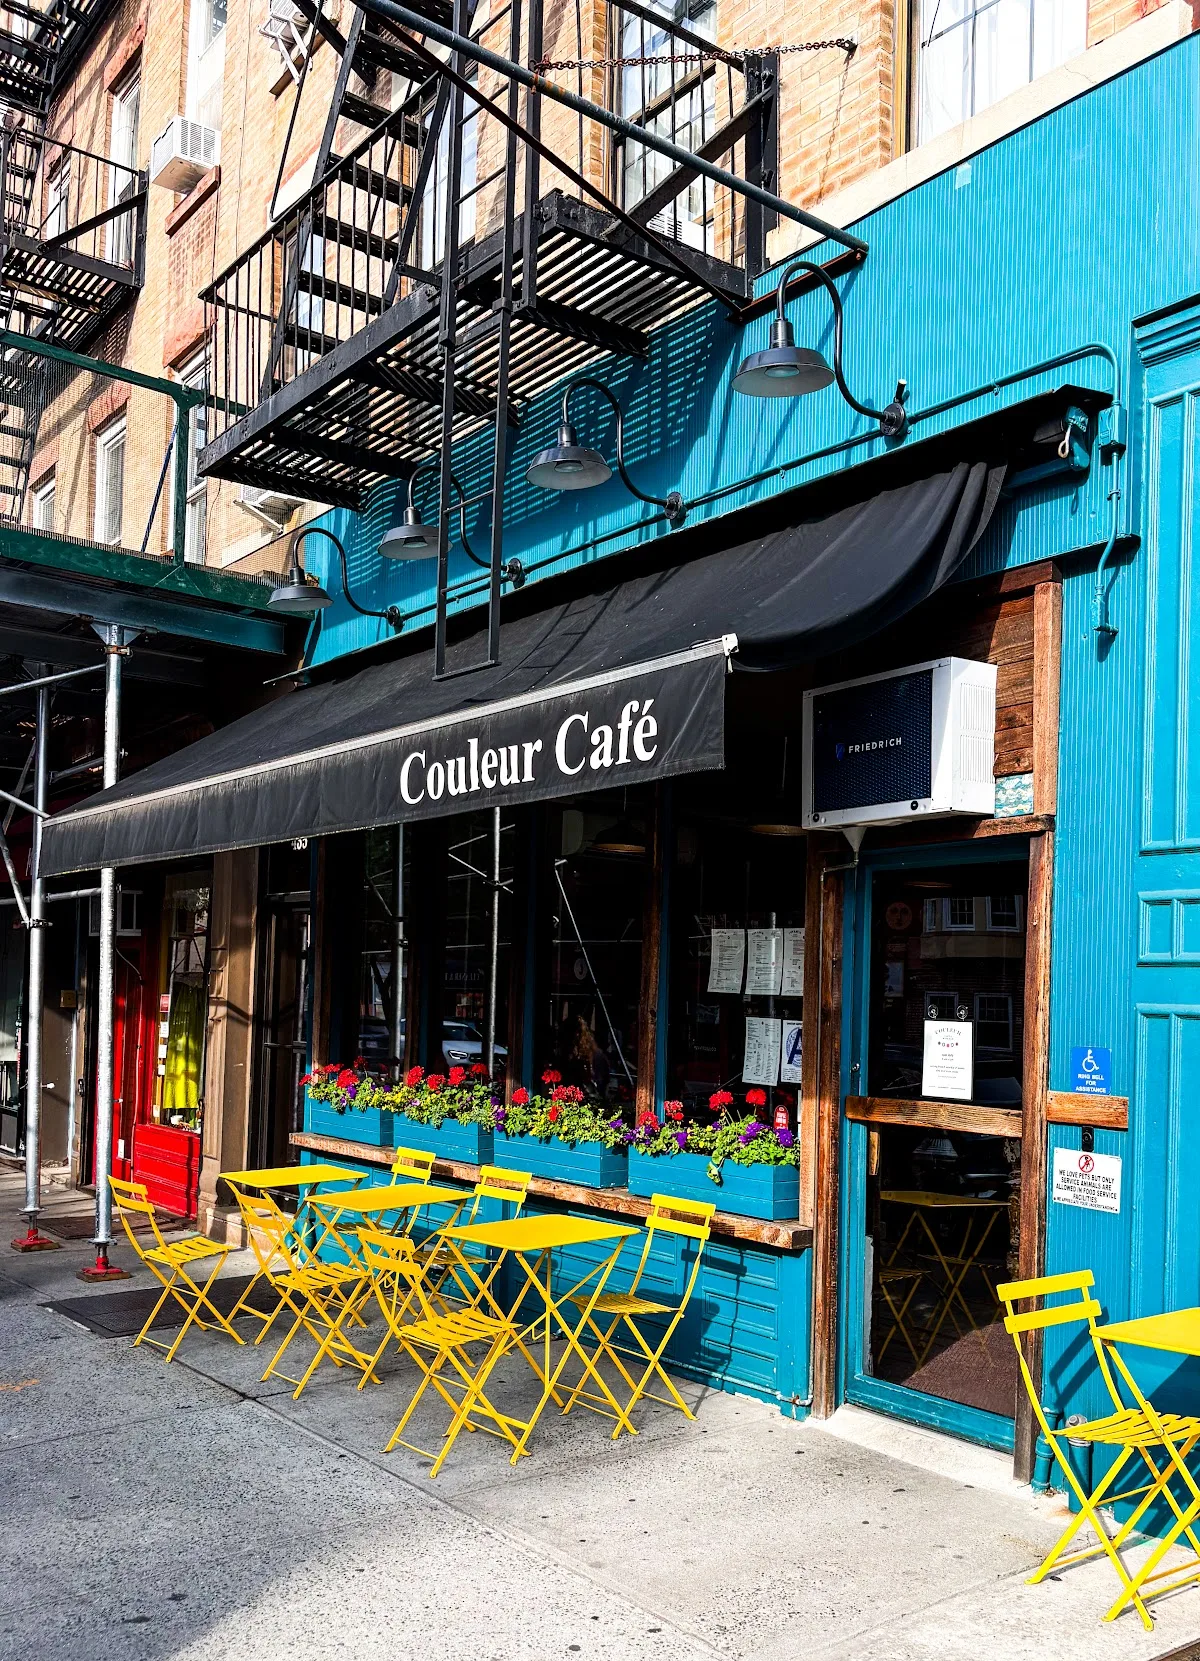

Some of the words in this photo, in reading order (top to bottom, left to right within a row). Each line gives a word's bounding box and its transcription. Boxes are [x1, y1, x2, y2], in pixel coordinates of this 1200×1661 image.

[400, 738, 543, 805] Couleur
[555, 698, 658, 775] Café
[848, 737, 902, 754] FRIEDRICH
[1061, 1177, 1079, 1185] SERVICE
[1081, 1180, 1101, 1189] ANIMALS
[1066, 1170, 1078, 1178] LOVE
[1091, 1174, 1101, 1182] BUT
[1102, 1176, 1115, 1184] ONLY
[1056, 1183, 1076, 1192] ALLOWED
[1083, 1188, 1096, 1196] FOOD
[1097, 1190, 1117, 1199] SERVICE
[1073, 1194, 1097, 1203] FACILITIES
